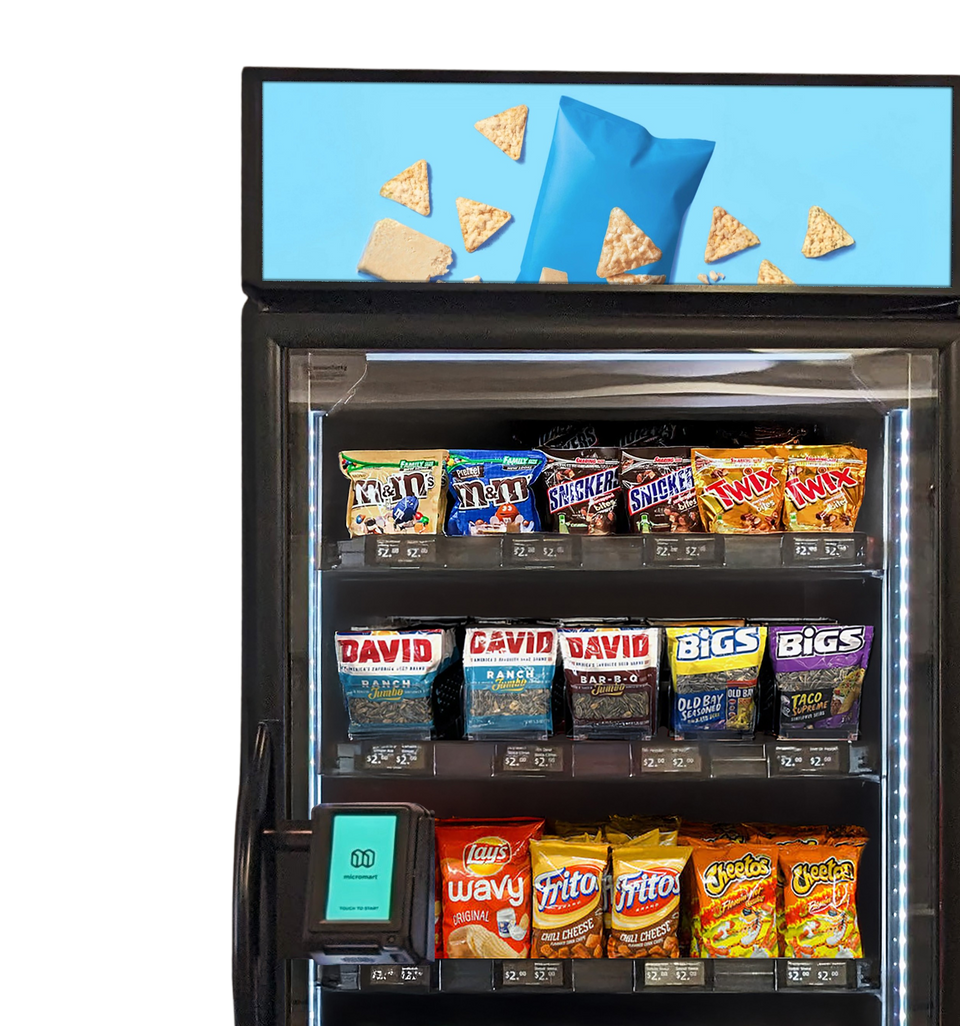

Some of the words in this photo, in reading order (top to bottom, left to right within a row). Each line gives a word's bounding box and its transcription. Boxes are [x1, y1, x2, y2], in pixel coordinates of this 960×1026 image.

[338, 639, 432, 663] DAVID
[470, 631, 553, 654] DAVID
[566, 634, 649, 659] DAVID
[487, 671, 534, 679] RANCH
[580, 674, 638, 684] BAR-B-Q
[361, 680, 411, 688] RANCH
[492, 678, 527, 691] Jumbo
[591, 682, 625, 696] Jumbo
[368, 687, 403, 700] Jumbo
[678, 696, 701, 711] OLD
[703, 693, 724, 707] BAY
[727, 689, 741, 698] OLD
[791, 692, 822, 709] TACO
[681, 703, 721, 720] SEASONED
[792, 700, 829, 717] SUPREME
[466, 842, 510, 865] Lay's
[704, 853, 771, 897] Cheetos
[448, 874, 524, 907] wavy
[535, 867, 599, 913] Frito
[453, 910, 490, 926] ORIGINAL
[541, 929, 562, 942] CHILI
[562, 918, 595, 938] CHEESE
[620, 933, 639, 943] CHILI
[640, 923, 672, 939] CHEESE
